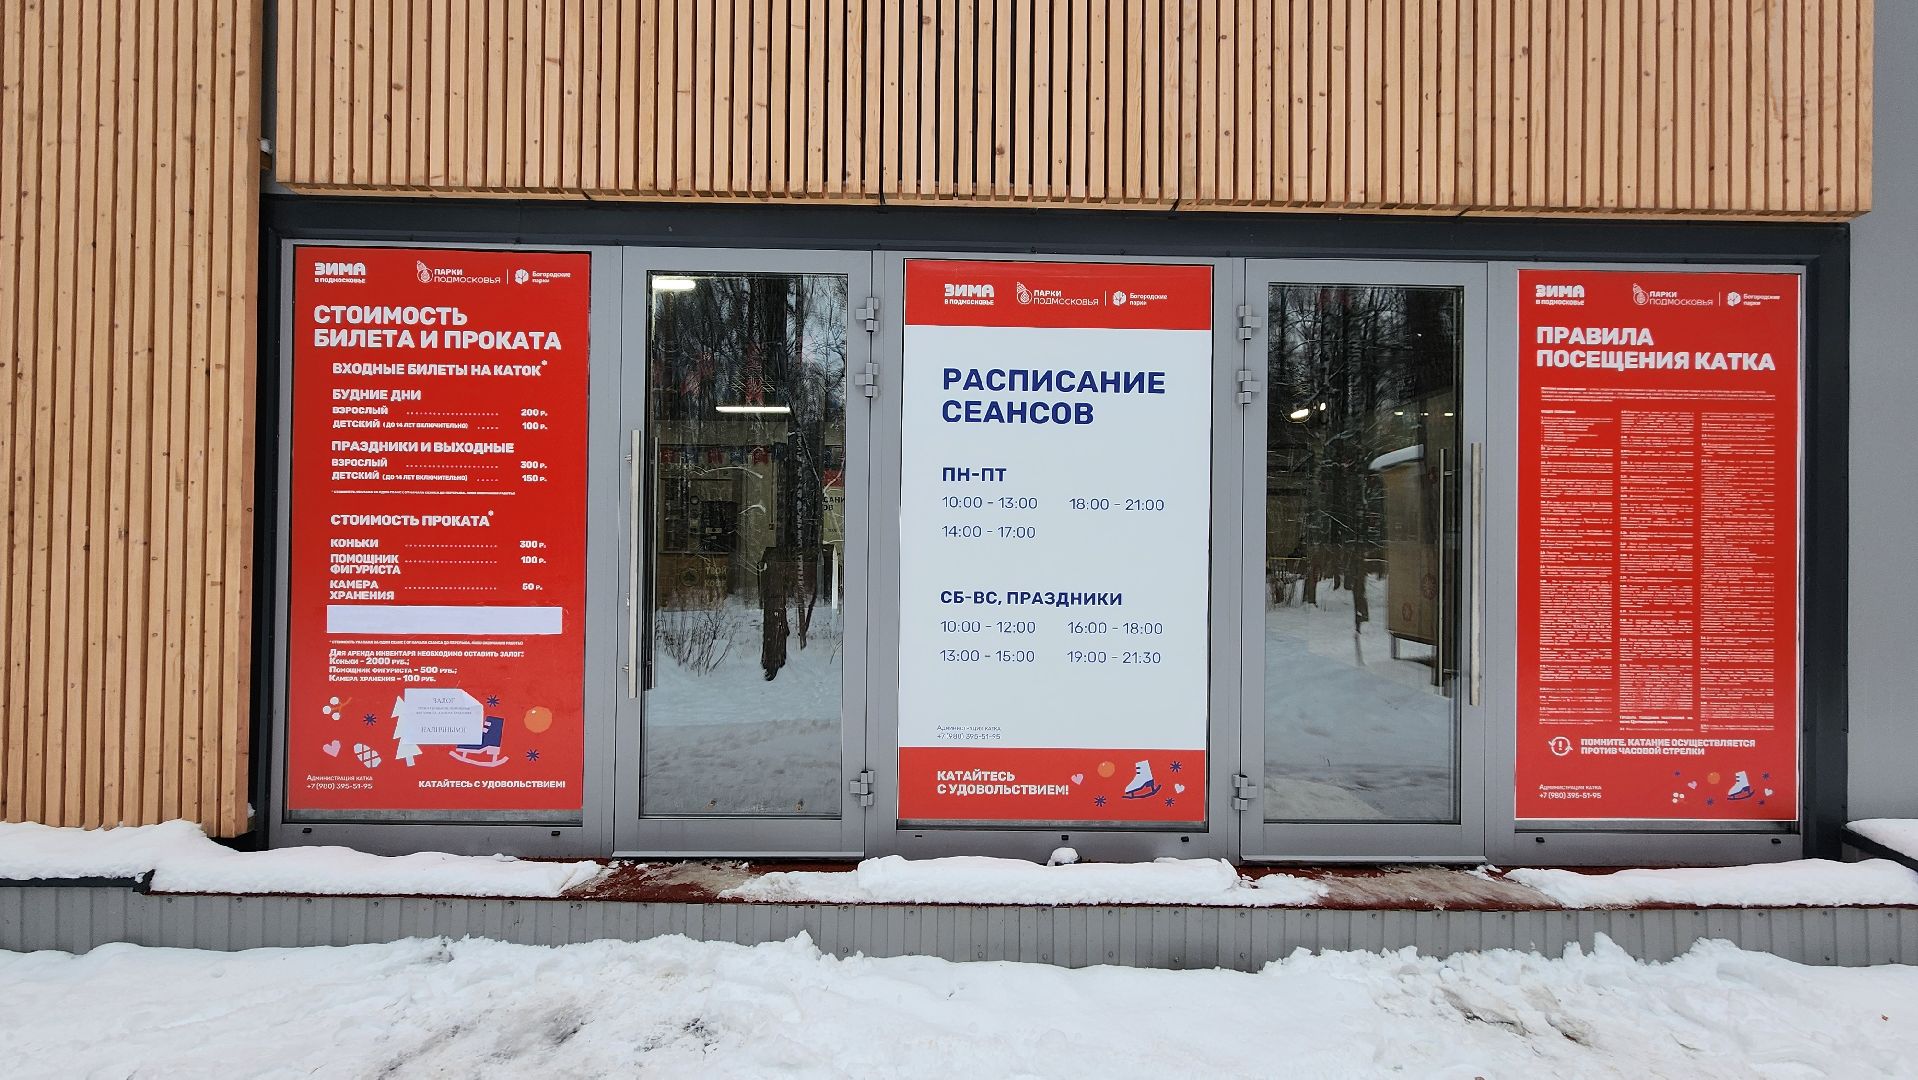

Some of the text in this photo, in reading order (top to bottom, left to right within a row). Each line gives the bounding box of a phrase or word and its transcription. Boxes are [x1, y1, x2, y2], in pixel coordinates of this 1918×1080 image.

[314, 262, 366, 276] ЗИМА
[434, 276, 501, 284] ПОДМОСКОВЬЯ
[944, 284, 995, 297] ЗИМА
[1536, 285, 1585, 297] ЗИМА
[1033, 297, 1099, 306] ПОДМОСКОВЬЯ
[1649, 298, 1713, 306] ПОДМОСКОВЬЯ
[313, 305, 468, 325] СТОИМОСТЬ
[313, 329, 562, 350] БИЛЕТА И ПРОКАТА
[1537, 327, 1654, 346] ПРАВИЛА
[1537, 350, 1776, 371] ПОСЕЩЕНИЯ КАТКА
[332, 363, 404, 376] ВХОДНЫЕ
[408, 364, 467, 376] БИЛЕТЫ
[470, 364, 491, 376] НА
[943, 368, 1166, 394] РАСПИСАНИЕ
[332, 389, 421, 401] БУДНИЕ ДНИ
[332, 405, 388, 415] ВЗРОСЛЫЙ
[520, 408, 539, 417] 200
[942, 400, 1094, 425] СЕАНСОВ
[332, 419, 380, 429] ДЕТСКИЙ
[522, 422, 539, 430] 100
[331, 440, 514, 454] ПРАЗДНИКИ И ВЫХОДНЫЕ
[331, 457, 388, 467] ВЗРОСЛЫЙ
[520, 461, 539, 469] 300
[331, 470, 379, 481] ДЕТСКИЙ
[522, 474, 539, 482] 150
[942, 467, 1007, 482] ПН-ПТ
[942, 496, 983, 509] 10:00
[998, 497, 1038, 509] 13:00
[1069, 498, 1109, 510] 18:00
[1125, 499, 1165, 511] 21:00
[330, 514, 419, 526] СТОИМОСТЬ
[941, 526, 982, 538] 14:00
[997, 526, 1036, 539] 17:00
[330, 539, 379, 548] КОНЬКИ
[519, 540, 538, 549] 300
[330, 554, 399, 565] ПОМОЩНИК
[520, 556, 538, 564] 100
[330, 564, 401, 575] ФИГУРИСТА
[330, 580, 379, 589] КАМЕРА
[522, 583, 534, 591] 50
[330, 591, 395, 600] ХРАНЕНИЯ
[940, 590, 1123, 607] СБ-ВС, ПРАЗДНИКИ
[940, 620, 981, 633] 10:00
[996, 621, 1036, 634] 12:00
[1067, 621, 1108, 634] 16:00
[1123, 622, 1163, 635] 18:00
[940, 649, 980, 662] 13:00
[995, 650, 1035, 663] 15:00
[1067, 651, 1107, 663] 19:00
[1122, 651, 1161, 664] 21:30
[1628, 738, 1671, 747] КАТАНИЕ
[1671, 738, 1756, 748] ОСУЩЕСТВЛЯЕТСЯ
[1581, 746, 1705, 756] ПРОТИВ ЧАСОВОЙ СТРЕЛКИ
[937, 769, 1015, 782] КАТАЙТЕСЬ
[418, 779, 473, 788] КАТАЙТЕСЬ
[481, 780, 566, 790] УДОВОЛЬСТВИЕМ!
[937, 784, 1069, 796] С УДОВОЛЬСТВИЕМ!
